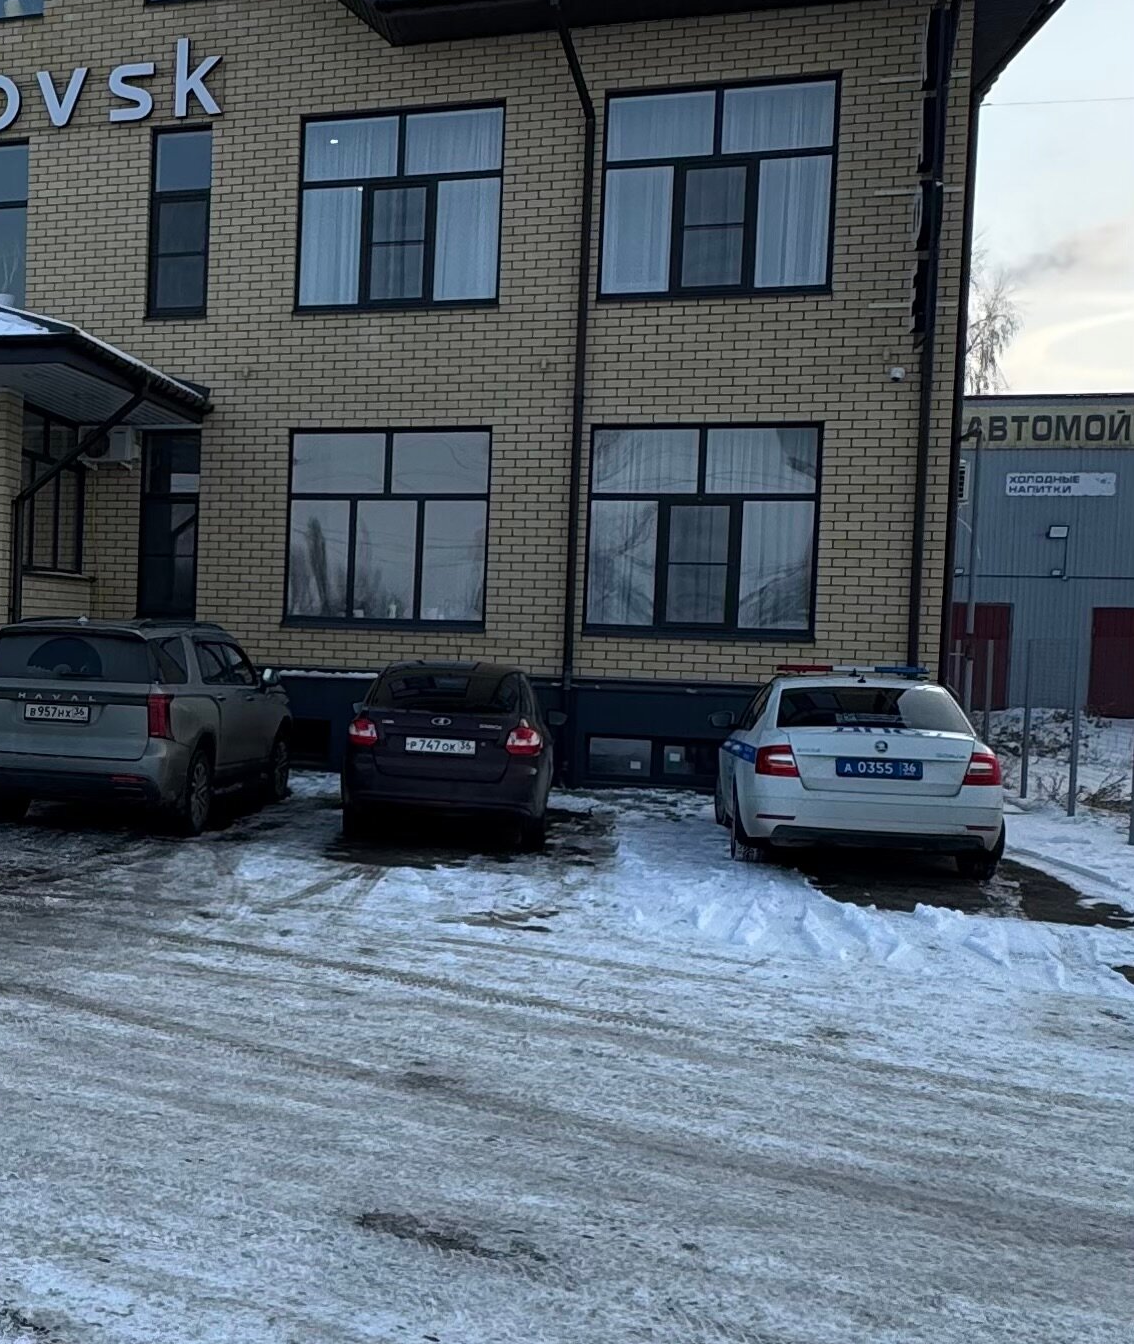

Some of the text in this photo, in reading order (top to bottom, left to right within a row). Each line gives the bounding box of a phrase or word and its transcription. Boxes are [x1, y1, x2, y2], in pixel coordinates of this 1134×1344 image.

[1009, 475, 1080, 484] ХОЛОДНЫЕ
[1009, 485, 1072, 494] НАПИТКИ
[18, 692, 96, 702] HAVAL
